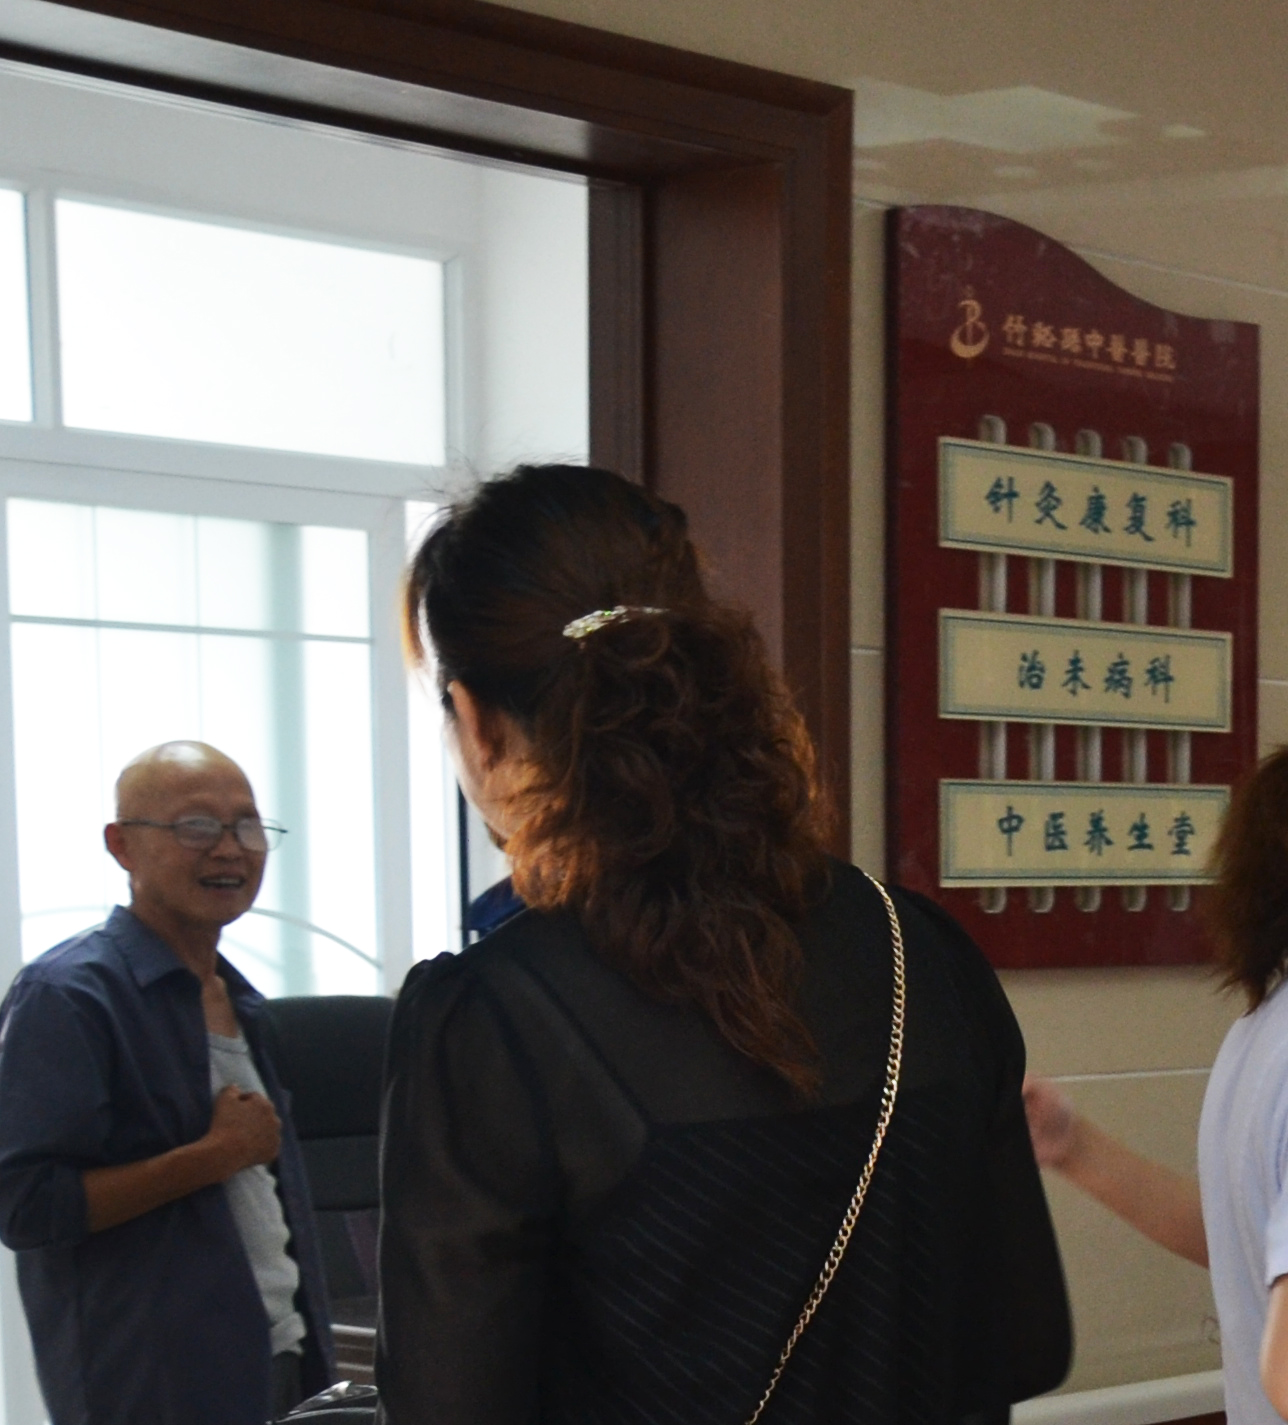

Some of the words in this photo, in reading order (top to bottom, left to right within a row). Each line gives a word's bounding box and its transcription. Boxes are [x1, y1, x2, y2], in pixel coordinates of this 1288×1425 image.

[985, 476, 1198, 547] 针灸康复科
[1017, 650, 1175, 703] 治未病科
[996, 804, 1196, 857] 中医养生堂
